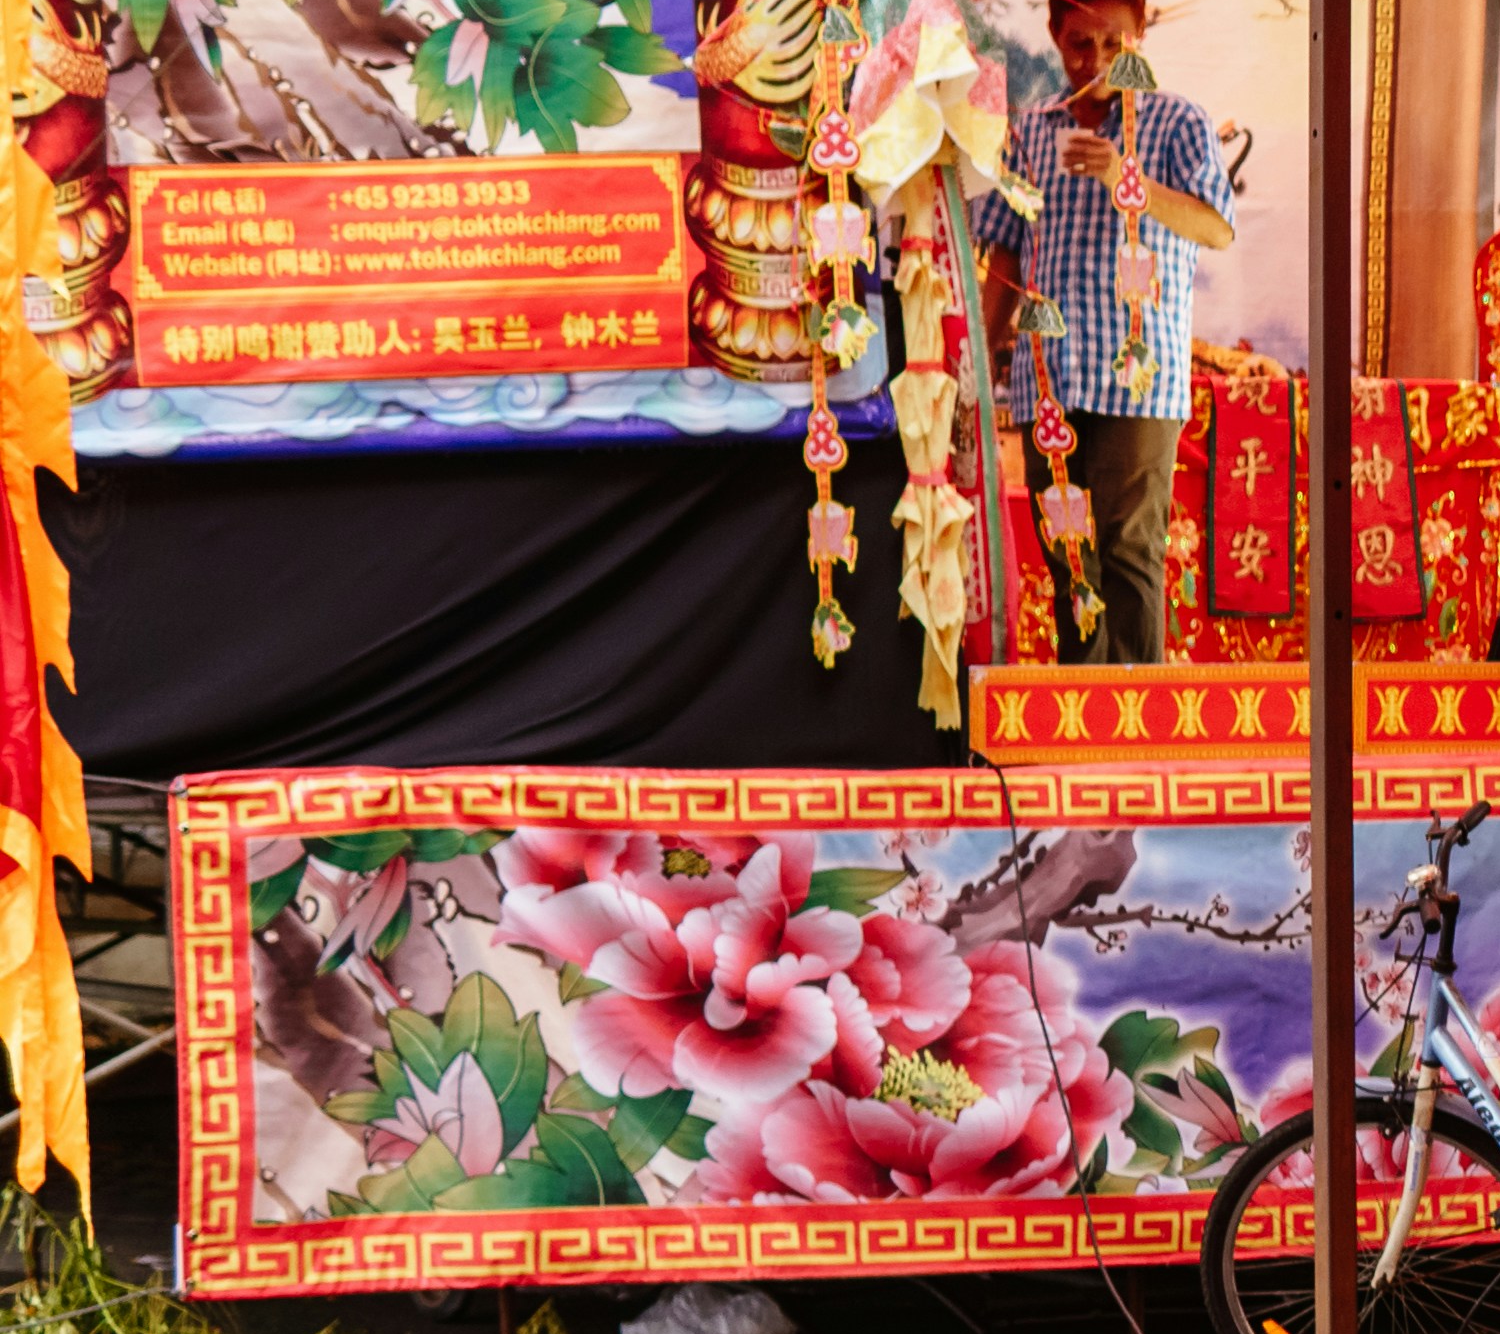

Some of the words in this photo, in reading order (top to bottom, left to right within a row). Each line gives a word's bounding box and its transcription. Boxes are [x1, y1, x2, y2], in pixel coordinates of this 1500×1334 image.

[162, 189, 199, 215] Tel
[391, 182, 459, 210] 9238
[462, 180, 531, 207] 3933
[162, 220, 228, 246] Email
[163, 251, 263, 277] Website
[344, 241, 622, 272] www.toktokchiang.com
